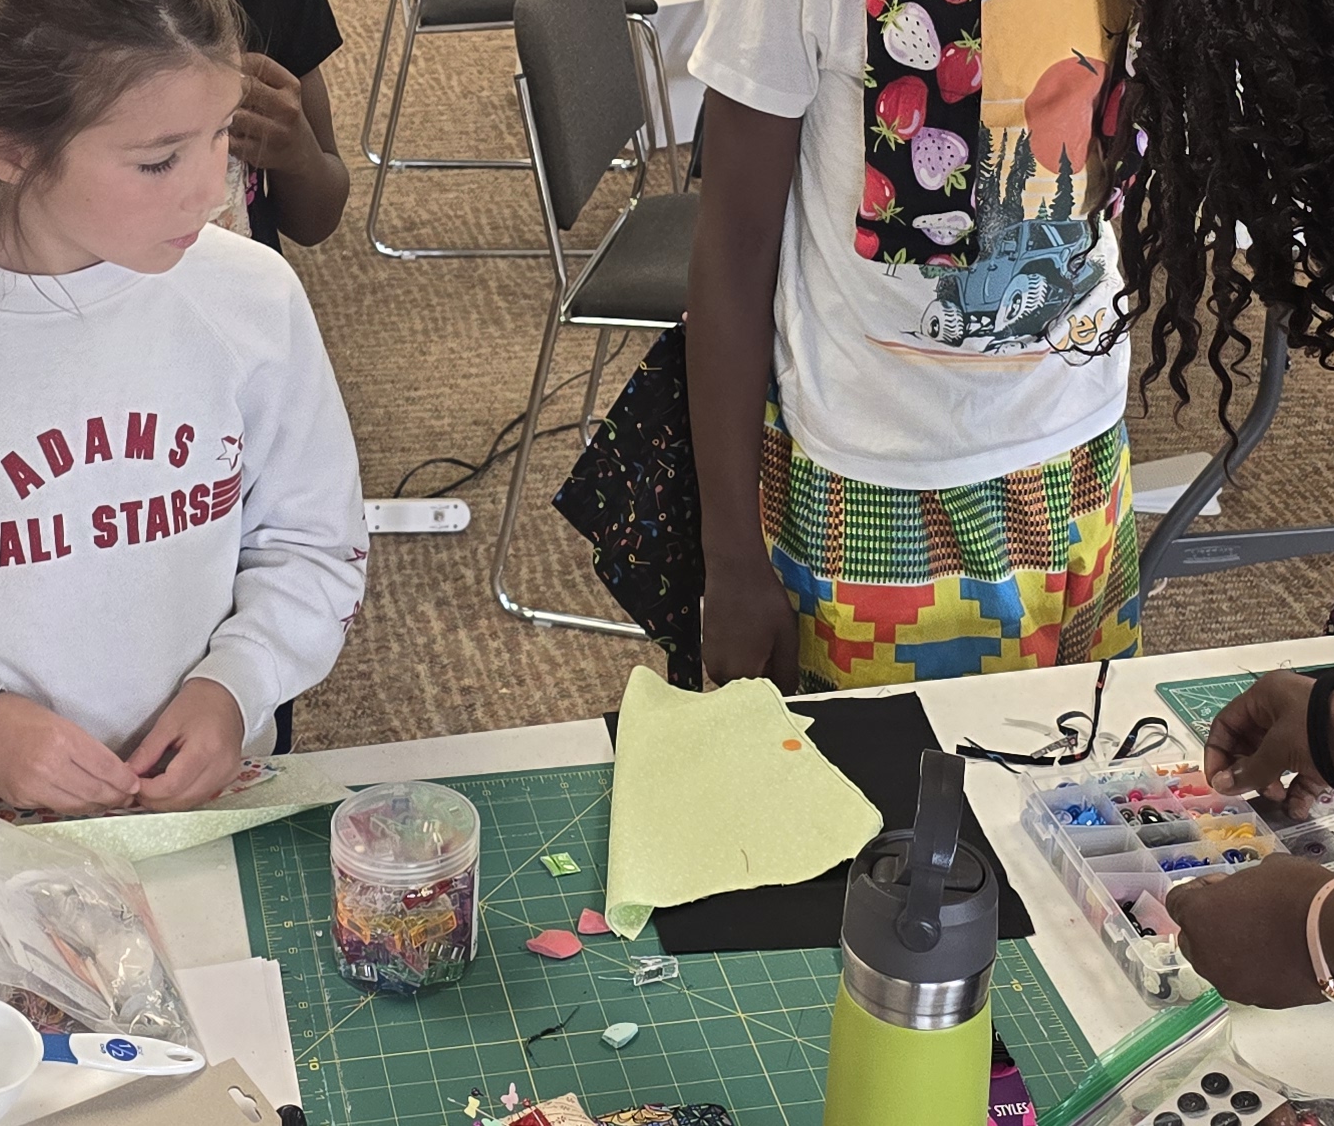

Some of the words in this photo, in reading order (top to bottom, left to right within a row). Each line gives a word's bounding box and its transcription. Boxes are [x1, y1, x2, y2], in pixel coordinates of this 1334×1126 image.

[0, 412, 195, 500] ADAMS
[0, 513, 71, 567] ALL
[92, 483, 211, 549] STARS
[283, 920, 294, 929] 5
[1010, 978, 1023, 992] 10
[308, 1056, 320, 1071] 10
[994, 1102, 1030, 1117] STYLES
